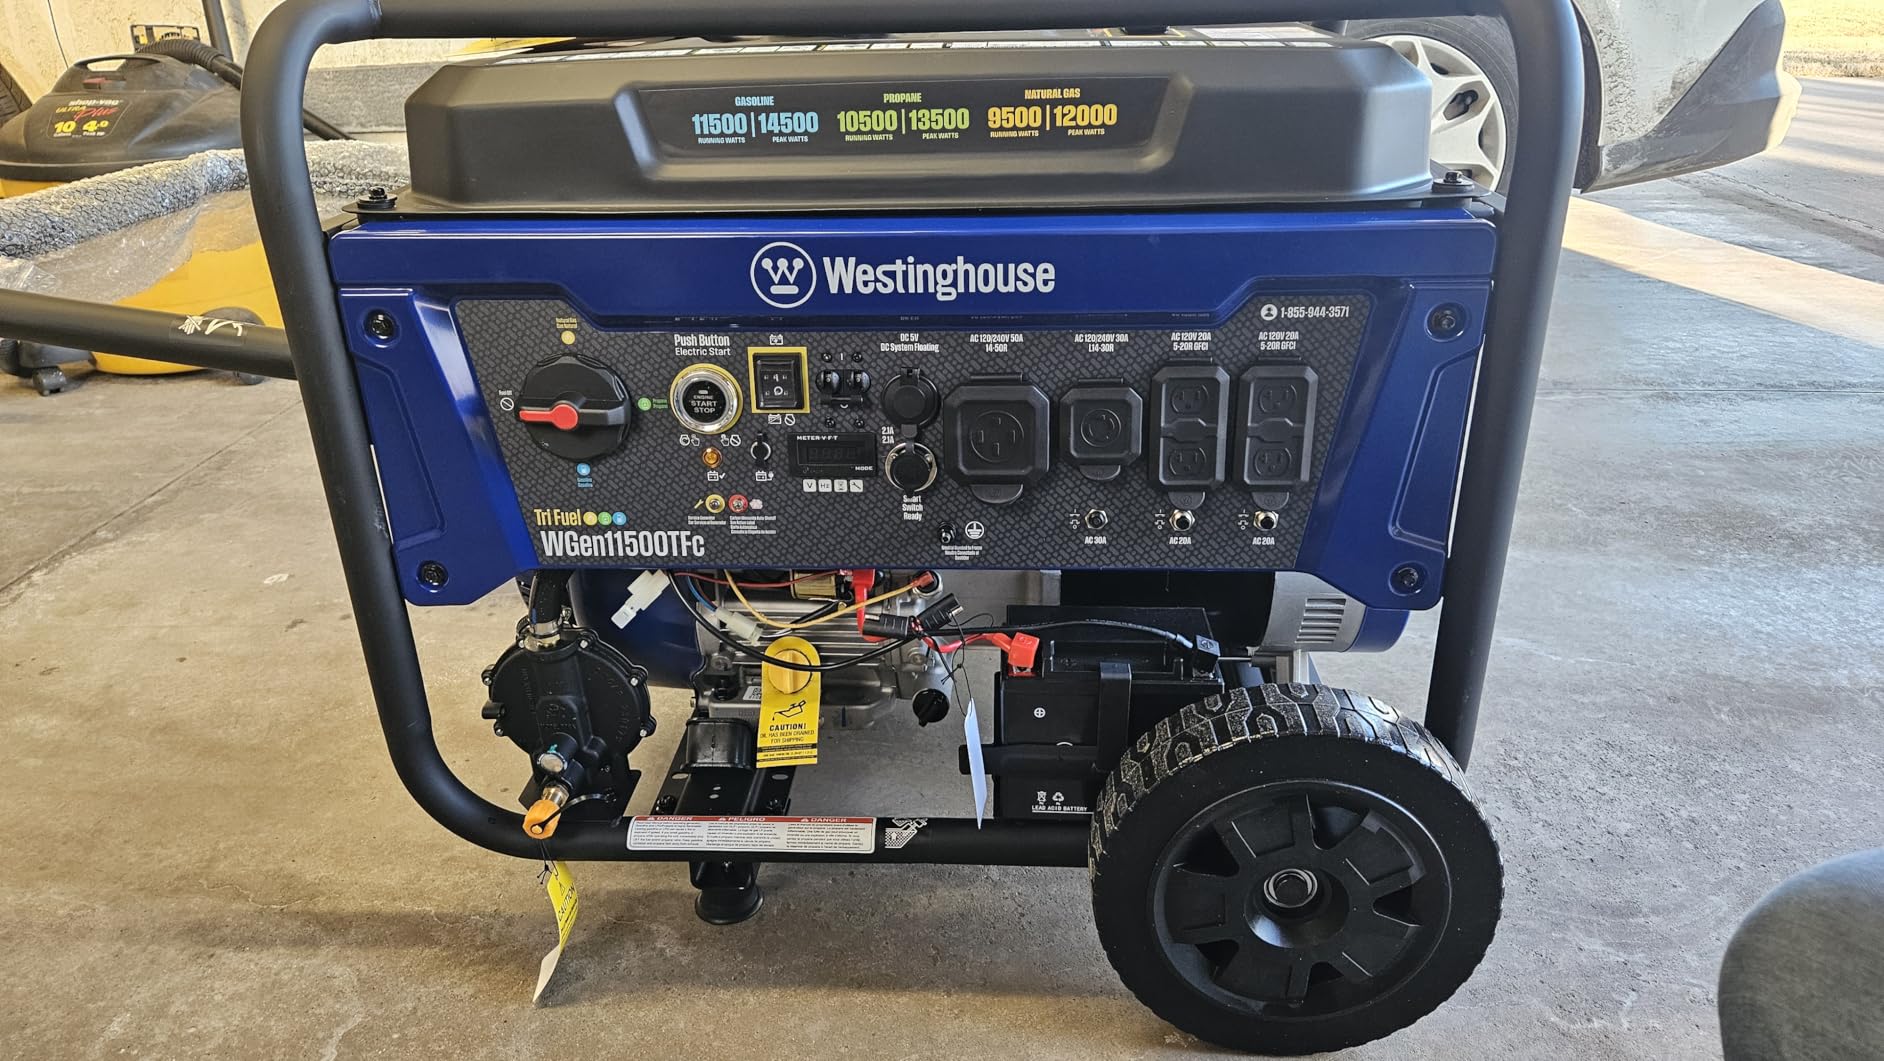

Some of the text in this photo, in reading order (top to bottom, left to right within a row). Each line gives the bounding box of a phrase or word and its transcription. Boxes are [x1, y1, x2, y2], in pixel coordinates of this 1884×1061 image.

[883, 92, 922, 103] PROPANE
[1024, 88, 1080, 99] NATURAL GAS
[735, 96, 774, 106] GASOLINE
[837, 108, 970, 132] 10500 13500
[987, 104, 1118, 128] 9500 12000
[54, 120, 76, 133] 10
[692, 111, 819, 135] 11500 14500
[990, 130, 1017, 138] RUNNING
[1067, 128, 1083, 136] PEAK
[822, 256, 1056, 301] Westinghouse
[1280, 306, 1350, 318] 1-855-944-3571
[674, 334, 730, 346] Push Button
[900, 333, 919, 341] DC 5V
[970, 334, 1024, 343] AC 120/240V 50A
[1074, 334, 1129, 343] AC 120/240V 30A
[1171, 332, 1211, 341] AC 120V 20A
[1258, 331, 1299, 340] AC 120V 20A
[881, 343, 940, 352] DC System Floating
[985, 344, 1008, 352] 14-50R
[1088, 344, 1114, 352] L14-30R
[1173, 342, 1209, 351] 5-20R GFCI
[1260, 341, 1296, 350] 5-20R GFCI
[675, 347, 731, 356] Electric Start
[902, 503, 923, 512] Switch
[534, 508, 582, 526] Tri Fuel
[903, 512, 922, 521] Ready
[540, 531, 705, 557] WGen11500TFc
[1084, 535, 1107, 544] AC 30A
[1169, 536, 1192, 545] AC 20A
[1252, 537, 1275, 545] AC 20A
[769, 723, 807, 731] CAUTION!
[558, 883, 576, 922] CAUTION
